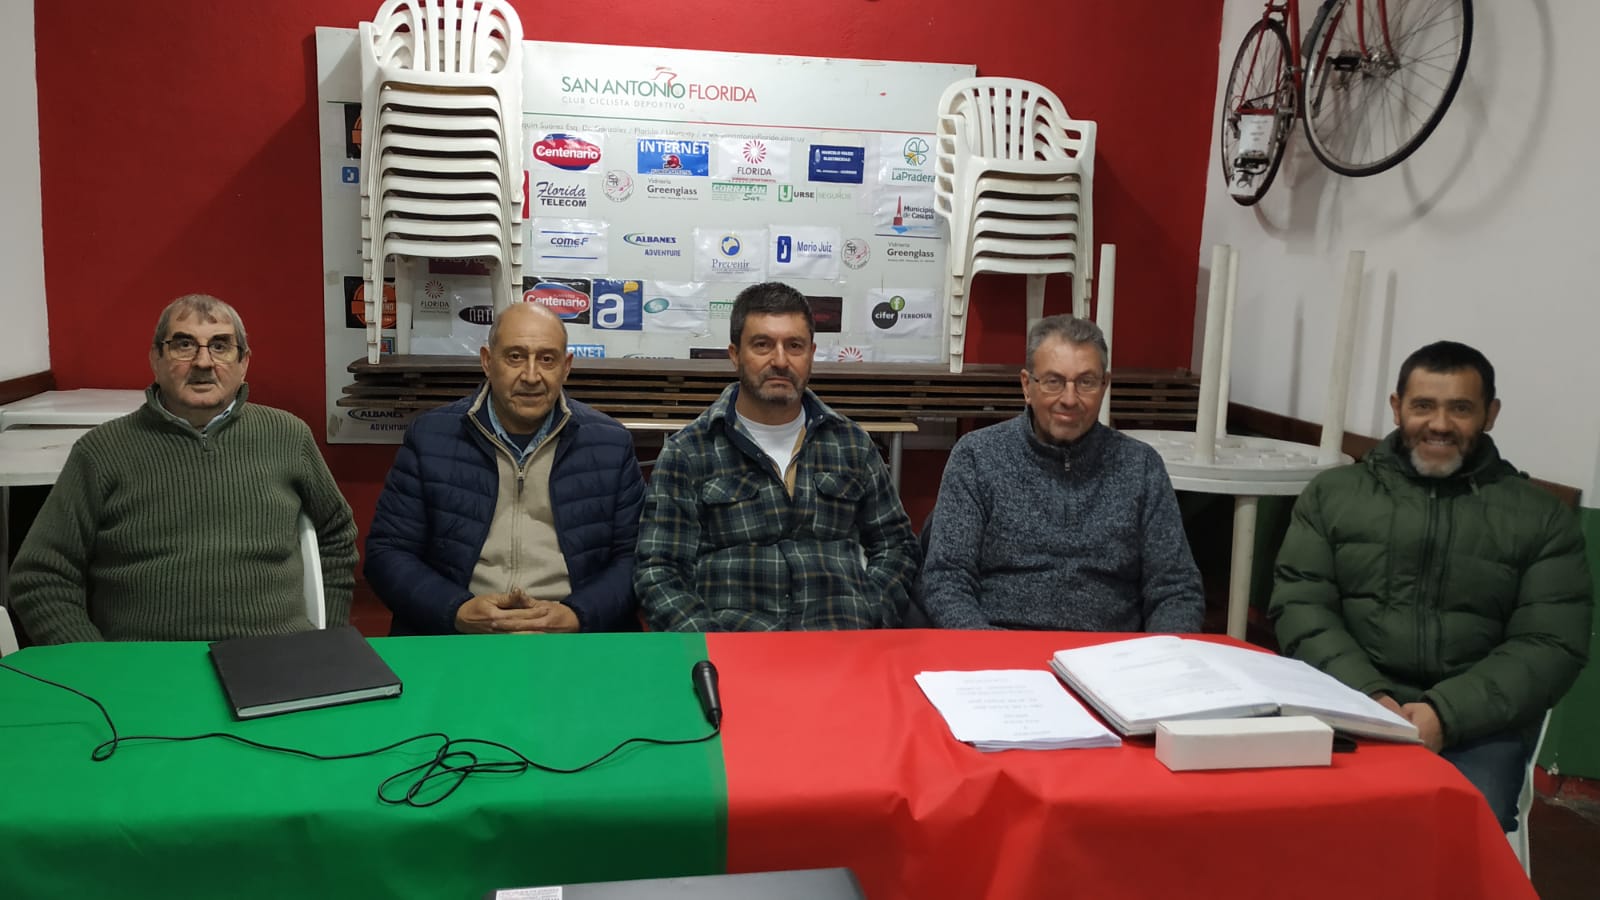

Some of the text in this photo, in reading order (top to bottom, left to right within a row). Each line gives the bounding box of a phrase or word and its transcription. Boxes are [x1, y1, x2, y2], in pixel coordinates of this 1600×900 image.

[561, 76, 757, 103] SAN ANTONIO FLORIDA
[561, 96, 686, 111] CLUB CICLISTA DEPORTIVO
[535, 145, 599, 160] Centenario
[639, 140, 710, 155] INTERNET
[737, 166, 772, 176] FLORIDA
[891, 171, 935, 183] LaPradera
[535, 181, 587, 198] Florida
[647, 184, 698, 197] Greenglass
[541, 198, 587, 208] TELECOM
[635, 235, 677, 244] ALBANES
[644, 248, 681, 257] ADVENTURE
[797, 240, 833, 253] Mario Juiz
[886, 248, 935, 259] Greenglass
[711, 258, 750, 270] Prevenir
[420, 300, 450, 308] FLORIDA
[875, 311, 932, 320] cifer FERROSUR
